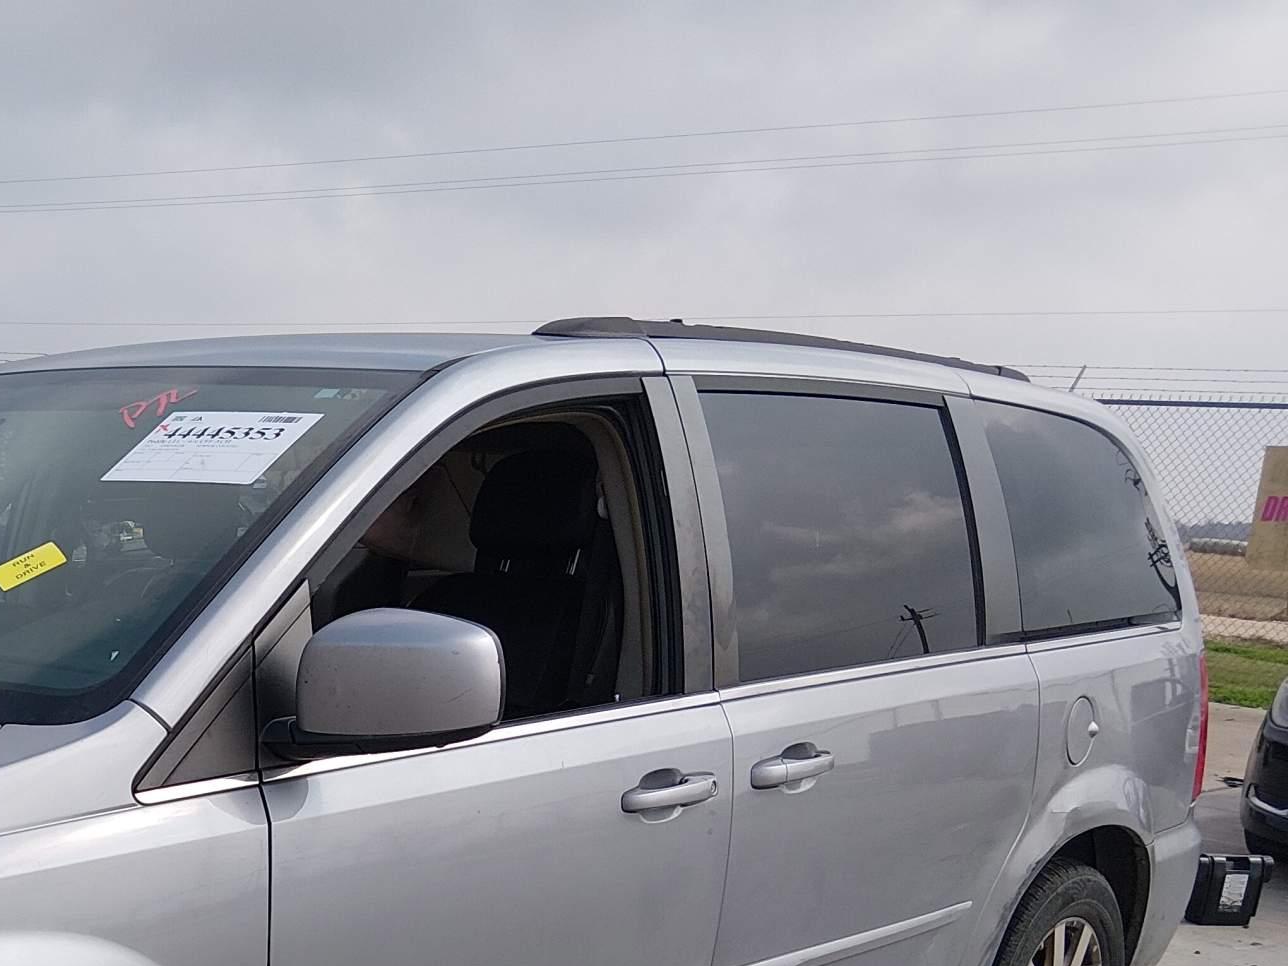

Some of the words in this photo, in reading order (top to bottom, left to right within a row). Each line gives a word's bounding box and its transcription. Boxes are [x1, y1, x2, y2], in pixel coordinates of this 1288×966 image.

[164, 426, 285, 441] 44445353
[12, 553, 35, 567] RUN
[15, 560, 47, 580] DRIVE
